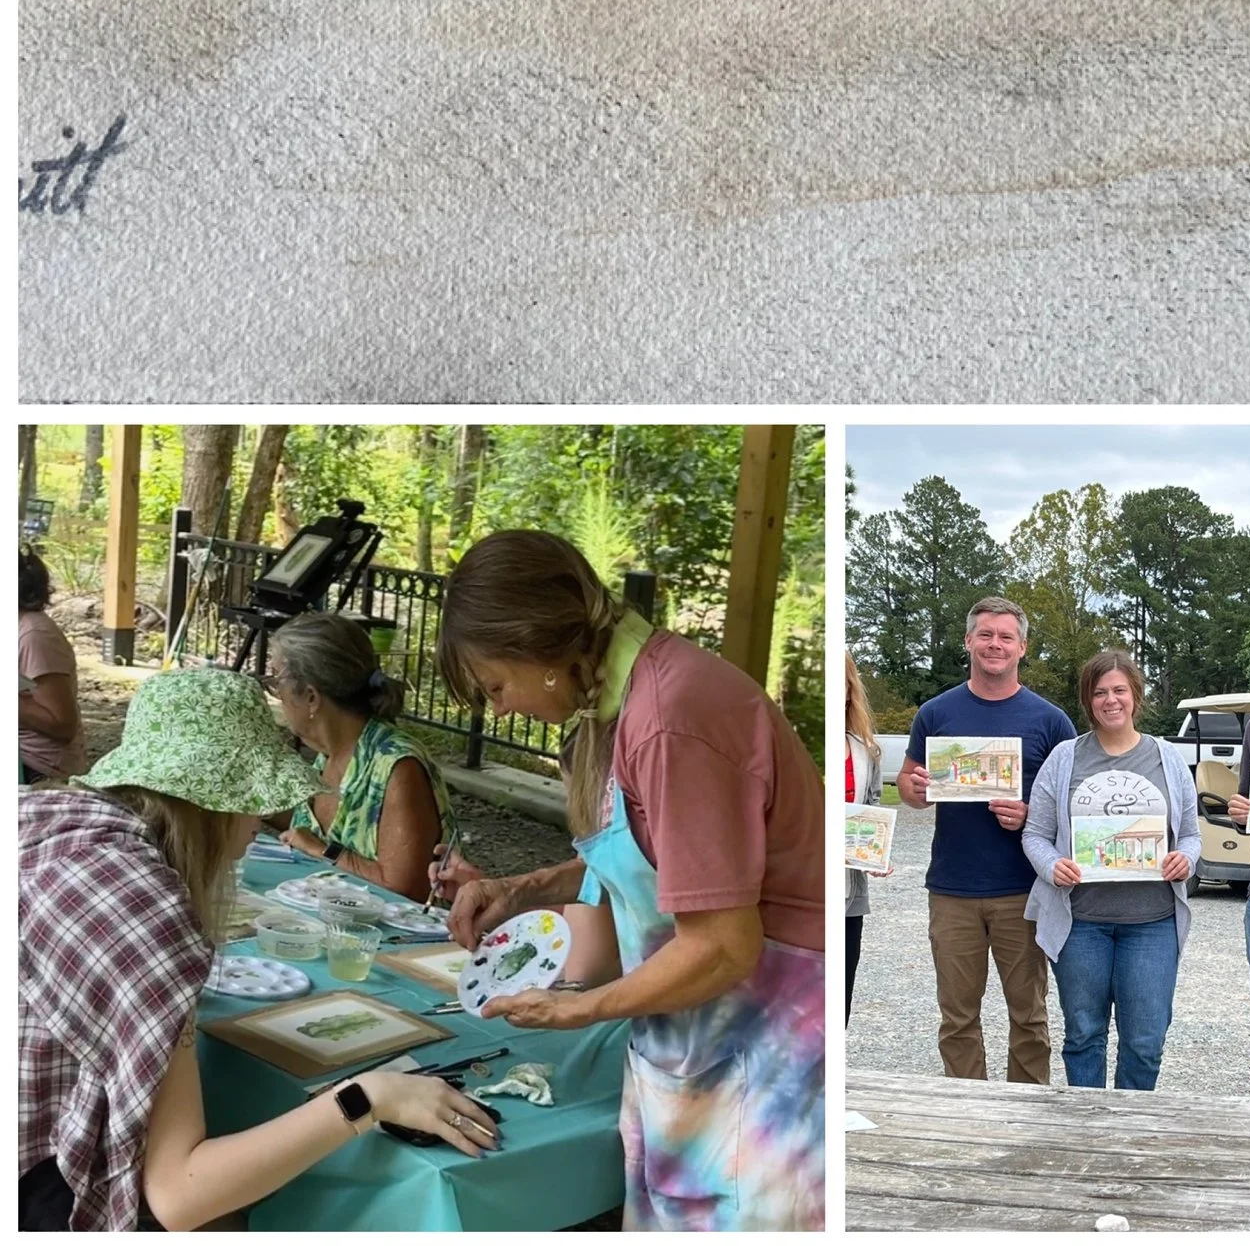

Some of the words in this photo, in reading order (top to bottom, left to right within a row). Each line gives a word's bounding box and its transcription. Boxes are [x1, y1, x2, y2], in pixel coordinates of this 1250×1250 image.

[18, 112, 130, 215] itt
[1078, 783, 1101, 805] BE
[1107, 776, 1160, 806] STILL
